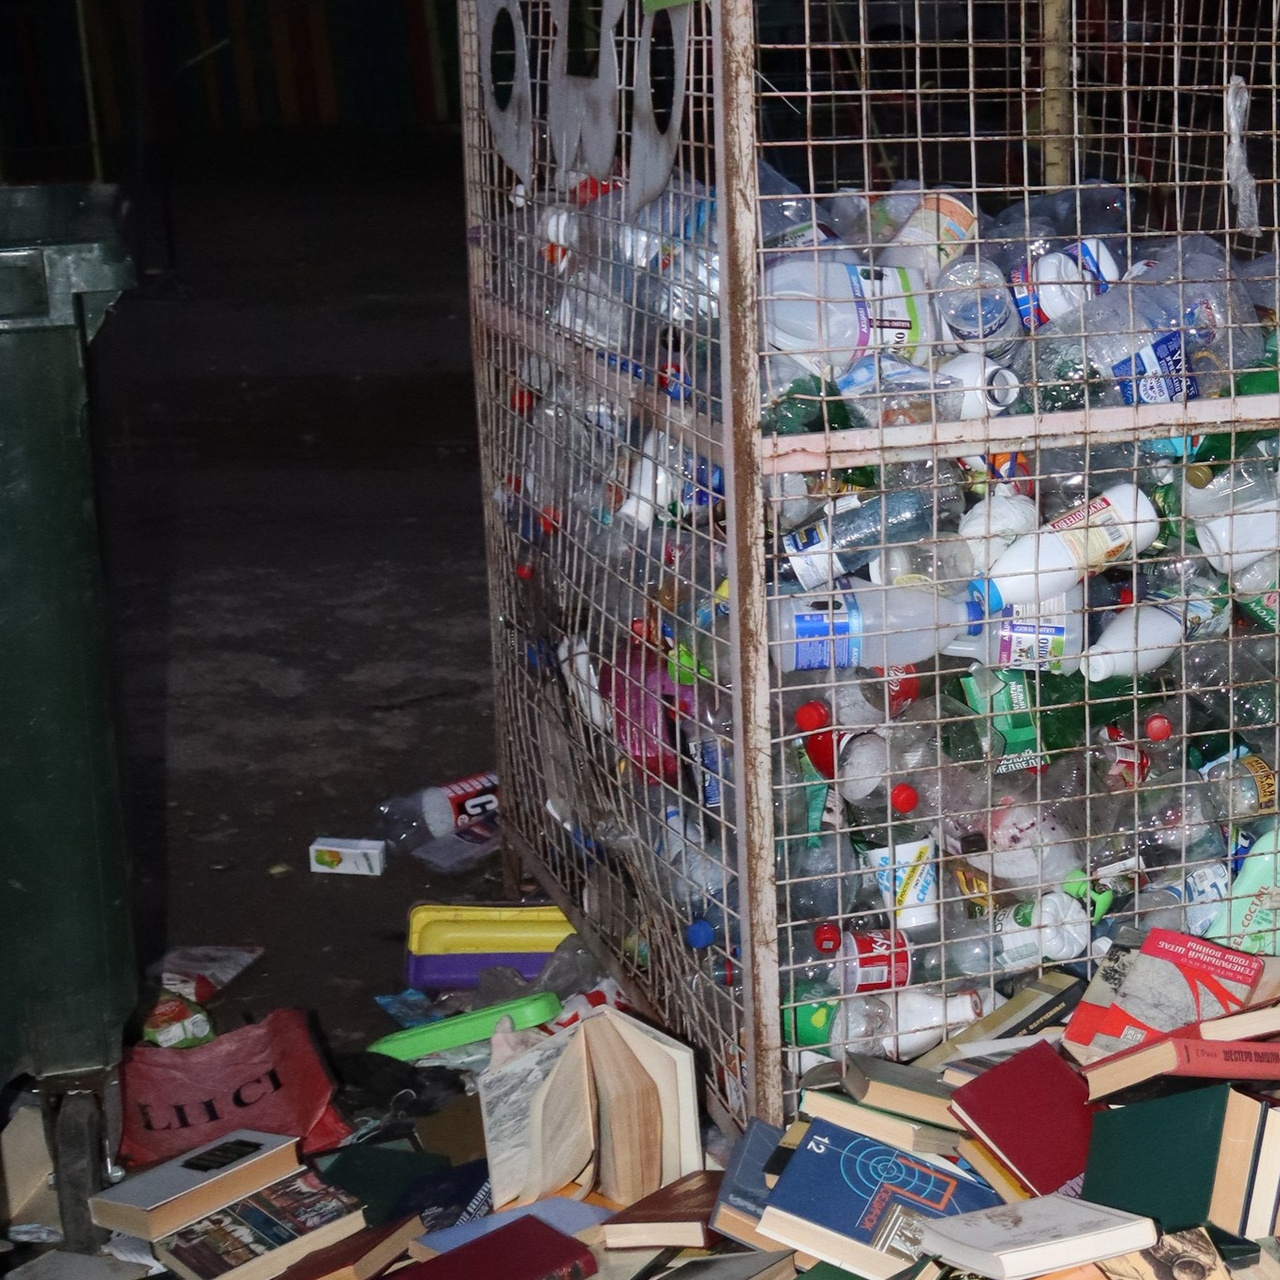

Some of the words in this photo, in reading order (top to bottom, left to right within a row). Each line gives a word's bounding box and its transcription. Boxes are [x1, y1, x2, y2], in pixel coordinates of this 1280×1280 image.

[1158, 940, 1186, 955] ШТАБ
[1187, 941, 1223, 958] ВОЙНЫ
[1188, 950, 1255, 976] ГЕНЕРАЛЬНЫЙ
[1225, 953, 1250, 967] ГОДЫ
[1222, 1050, 1252, 1062] ШЕСТЕРО
[1254, 1051, 1280, 1063] ВЫШЛИ
[808, 1133, 831, 1154] 12
